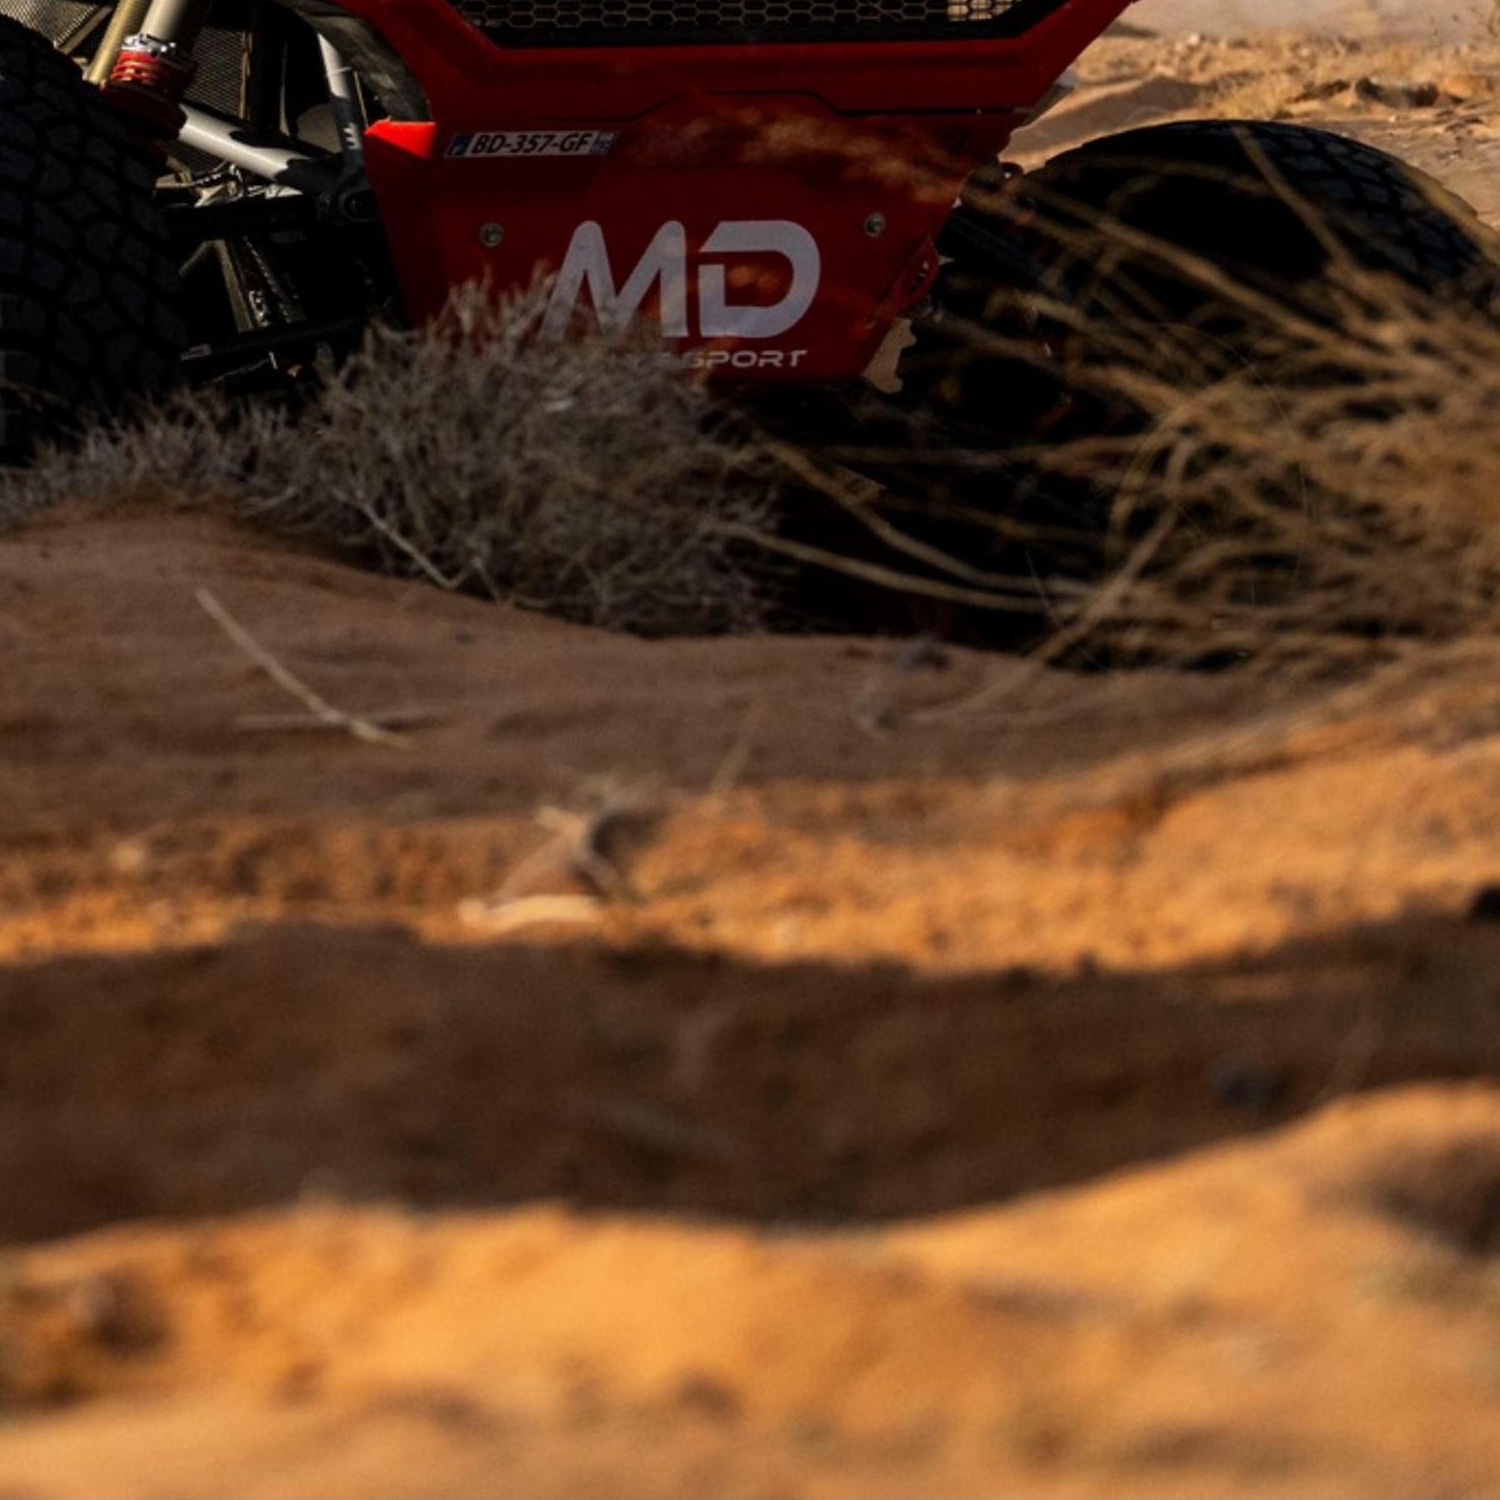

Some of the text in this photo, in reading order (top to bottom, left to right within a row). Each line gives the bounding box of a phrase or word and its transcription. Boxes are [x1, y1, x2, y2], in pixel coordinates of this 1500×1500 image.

[472, 134, 593, 154] BD-357-GF
[535, 220, 821, 338] MD
[689, 350, 807, 368] SPORT
